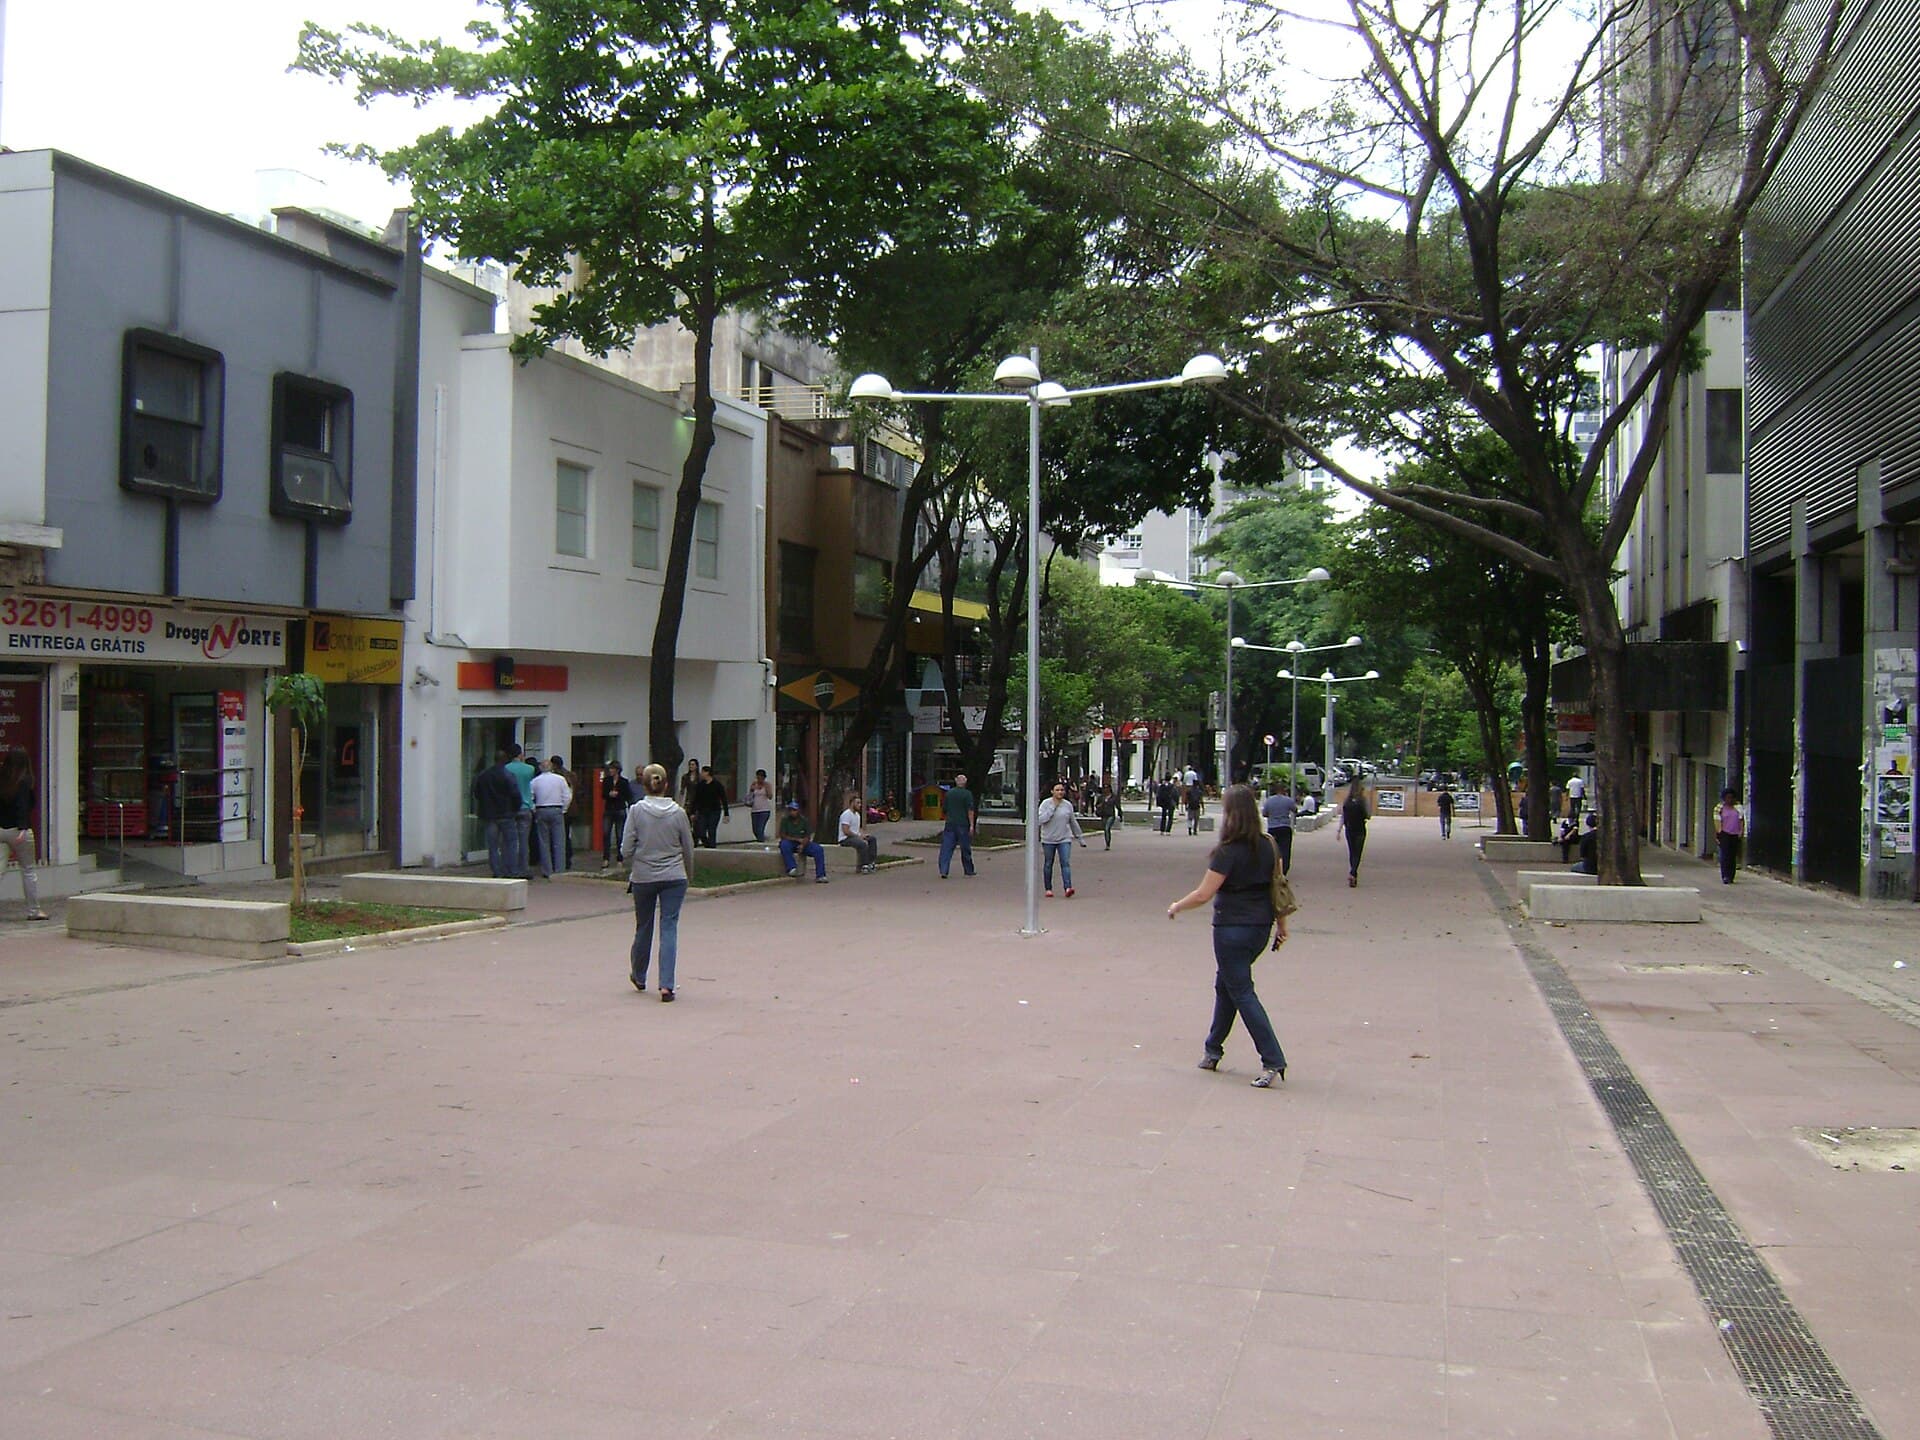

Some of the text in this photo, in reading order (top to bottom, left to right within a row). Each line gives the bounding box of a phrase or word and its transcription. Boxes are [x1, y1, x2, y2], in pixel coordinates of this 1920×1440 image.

[1, 597, 154, 634] 3261-4999
[8, 633, 145, 654] ENTREGA GRÁTIS
[233, 770, 240, 785] 3
[232, 801, 239, 817] 2
